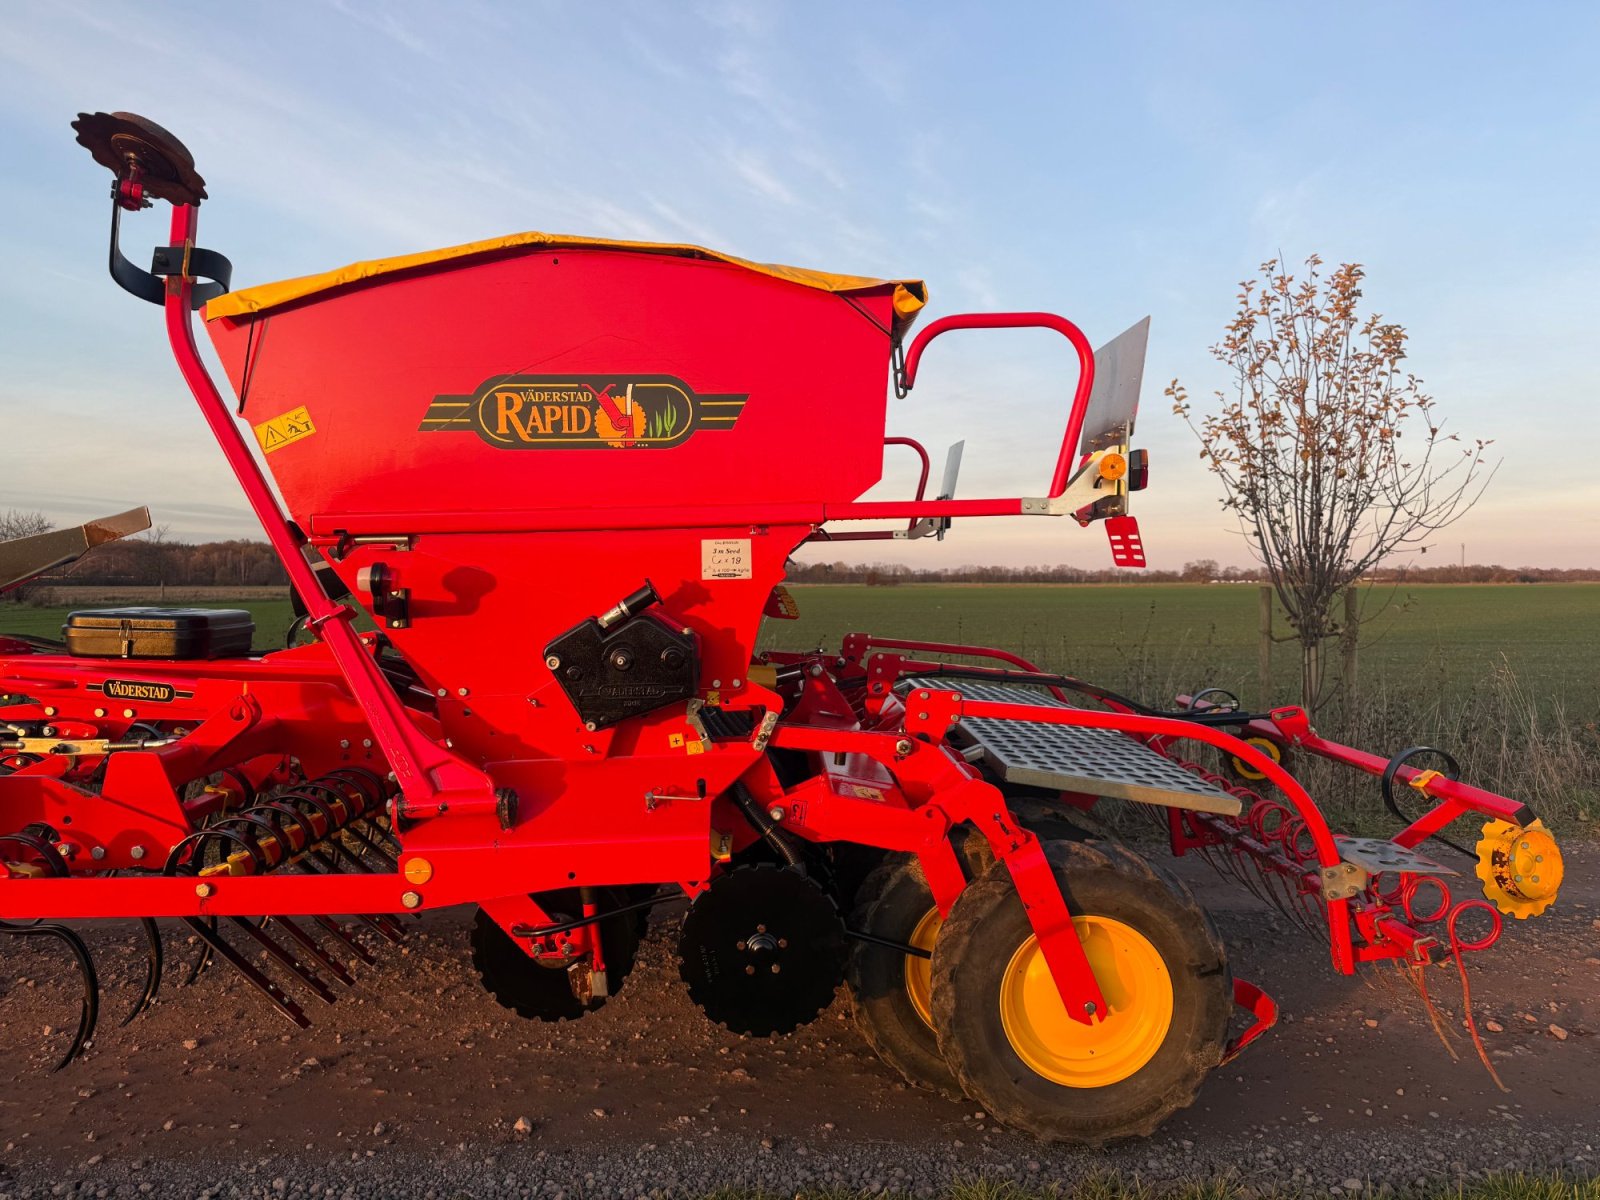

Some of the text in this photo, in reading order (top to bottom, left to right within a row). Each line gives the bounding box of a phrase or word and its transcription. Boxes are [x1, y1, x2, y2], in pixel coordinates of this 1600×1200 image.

[520, 389, 593, 402] VÄDERSTAD
[495, 392, 591, 442] RAPID
[108, 681, 168, 698] VÄDERSTAD
